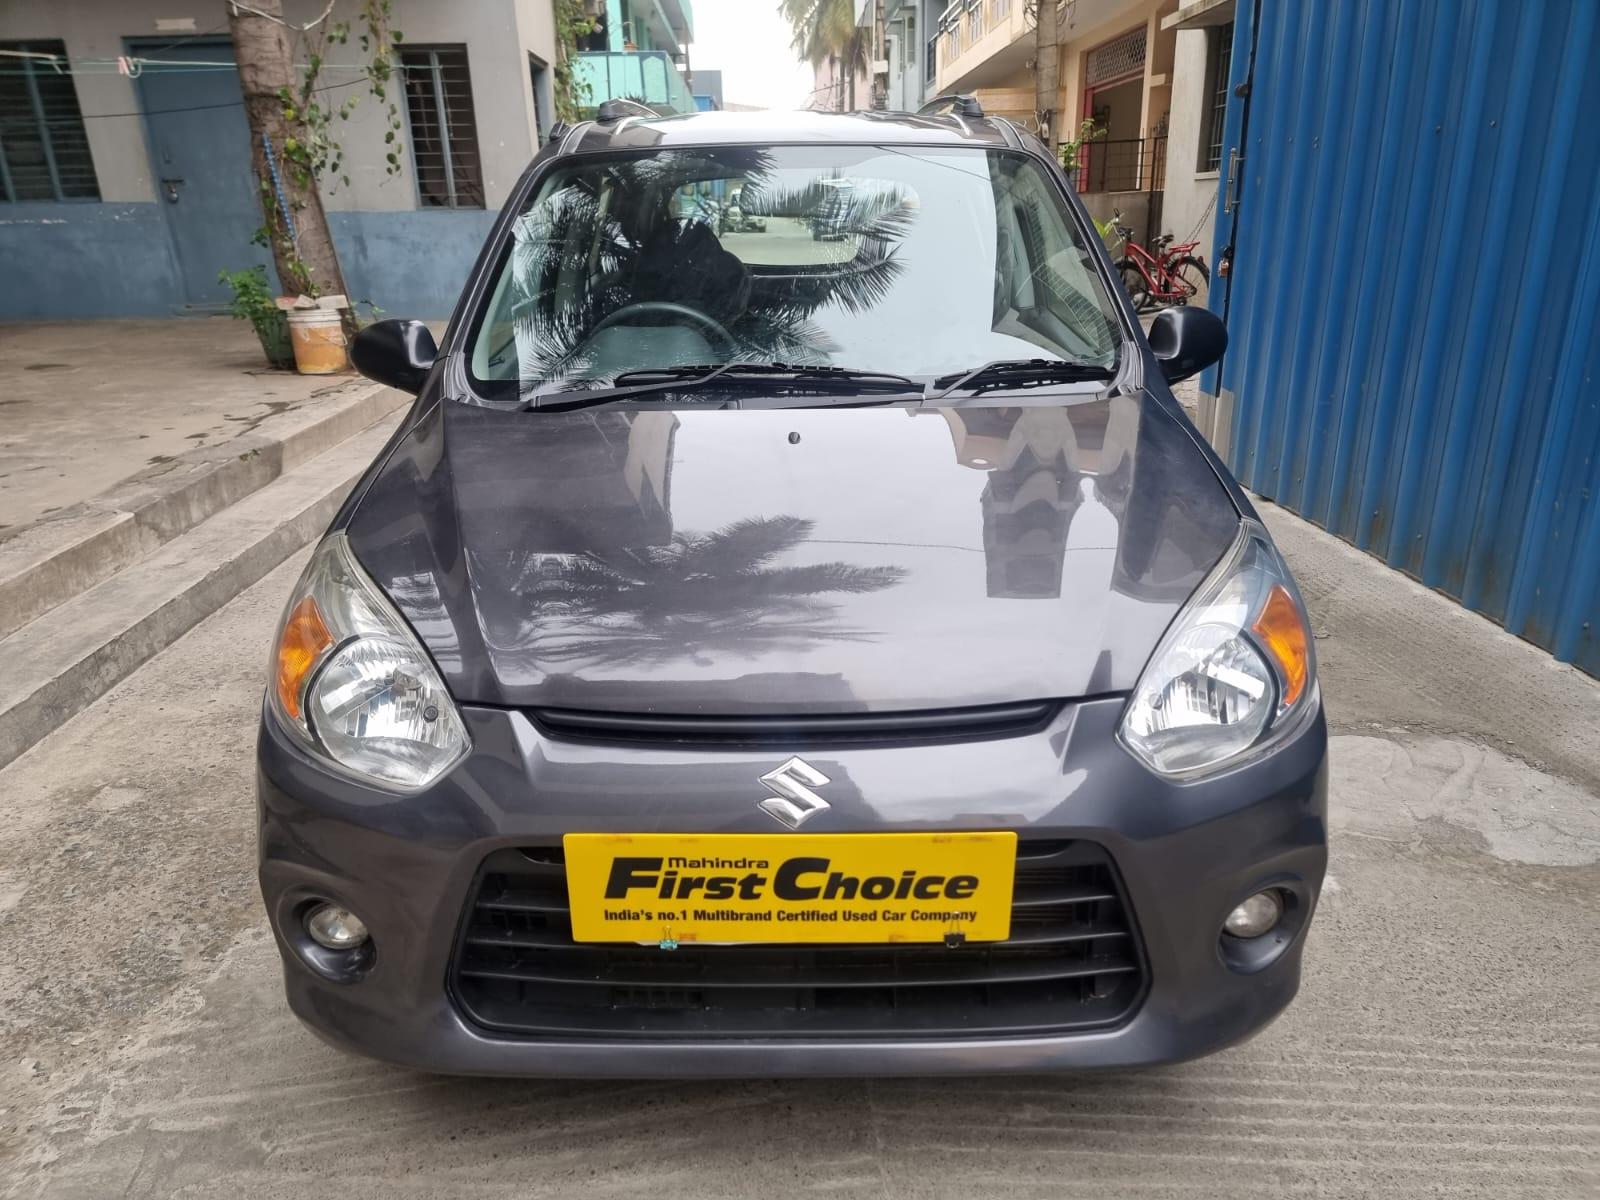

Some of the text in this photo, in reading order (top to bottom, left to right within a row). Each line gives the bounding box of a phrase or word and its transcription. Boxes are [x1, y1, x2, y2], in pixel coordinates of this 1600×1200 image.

[668, 857, 769, 869] Mahindra
[604, 856, 979, 901] First Choice
[604, 909, 977, 923] India's no.1 Multibrand Certified Used Car Company
